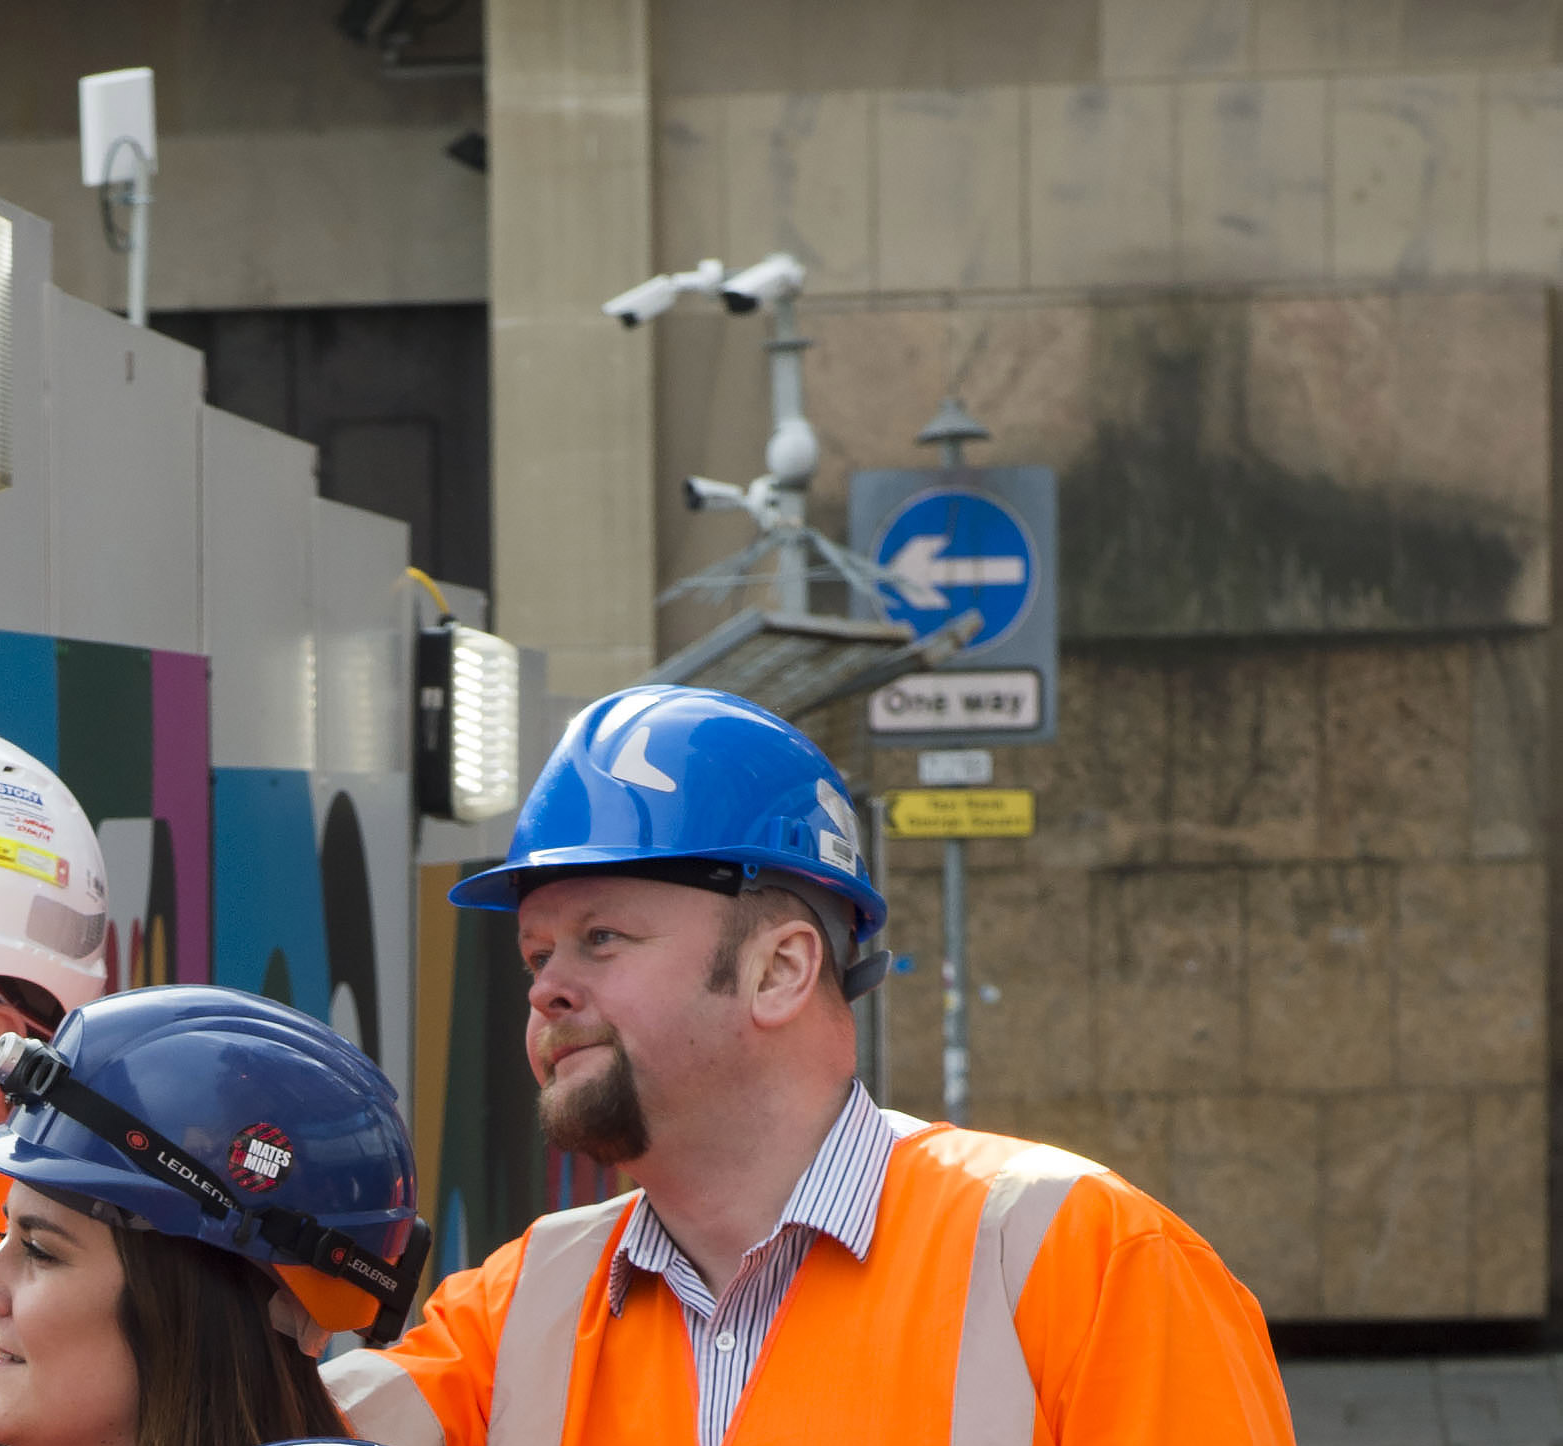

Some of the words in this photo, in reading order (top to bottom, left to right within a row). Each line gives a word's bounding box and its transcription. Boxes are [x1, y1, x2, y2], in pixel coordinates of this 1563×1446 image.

[884, 689, 948, 716] One
[960, 691, 1024, 719] way
[243, 1153, 280, 1179] MIND
[248, 1139, 292, 1167] MATES
